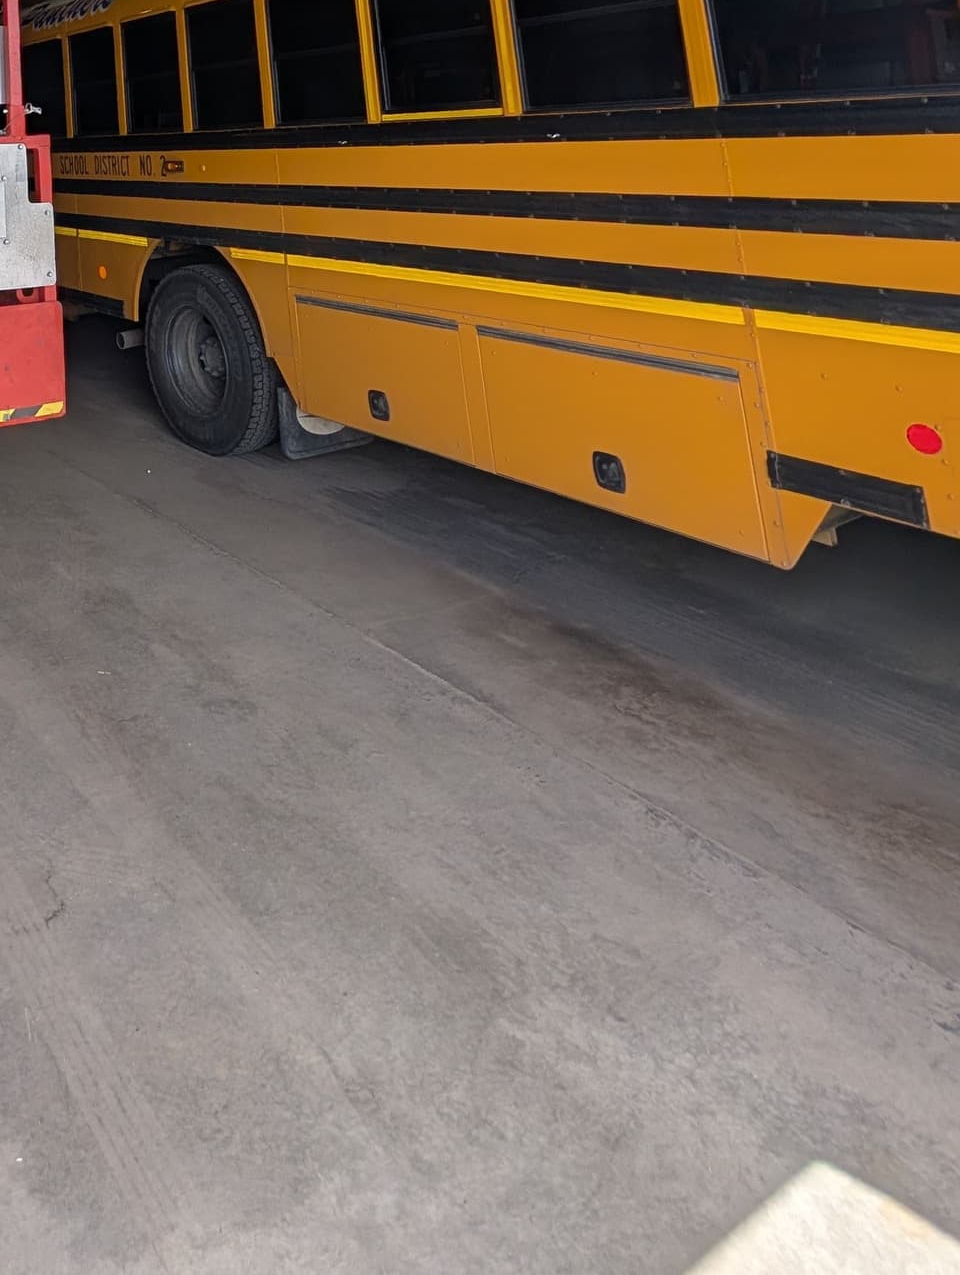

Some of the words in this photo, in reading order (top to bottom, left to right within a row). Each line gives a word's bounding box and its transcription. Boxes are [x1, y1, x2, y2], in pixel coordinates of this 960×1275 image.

[59, 154, 89, 176] SCHOOL
[94, 155, 130, 177] DISTRICT
[139, 154, 156, 177] NO.
[160, 154, 168, 177] 2
